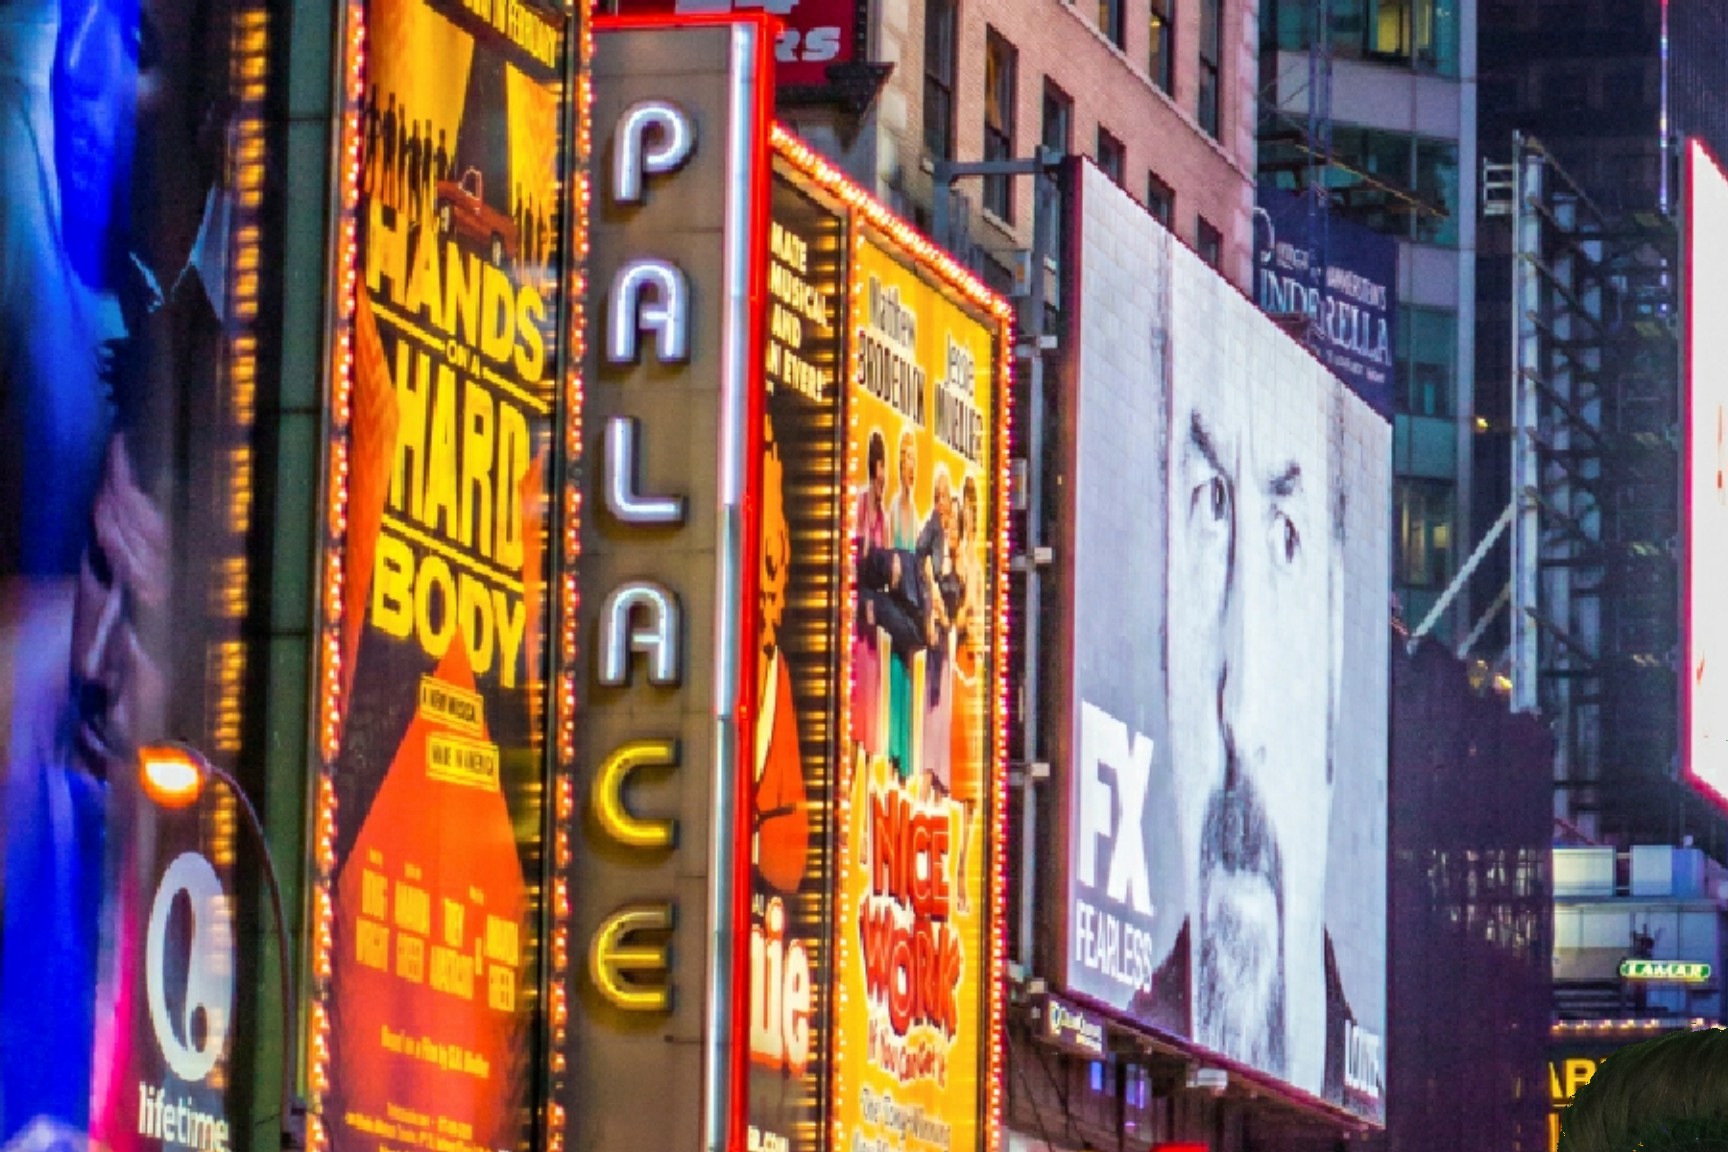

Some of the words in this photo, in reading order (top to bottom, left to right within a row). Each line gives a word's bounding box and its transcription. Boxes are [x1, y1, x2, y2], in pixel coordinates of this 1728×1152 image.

[366, 198, 547, 382] HANDS
[447, 339, 469, 371] ON
[388, 338, 530, 572] HARD
[371, 536, 526, 689] BODY
[589, 101, 697, 1013] PALACE
[869, 786, 952, 921] NICE
[1080, 699, 1155, 917] FX
[859, 898, 963, 1042] WORK
[1074, 902, 1153, 993] FEARLESS
[1628, 963, 1704, 979] LAMAR
